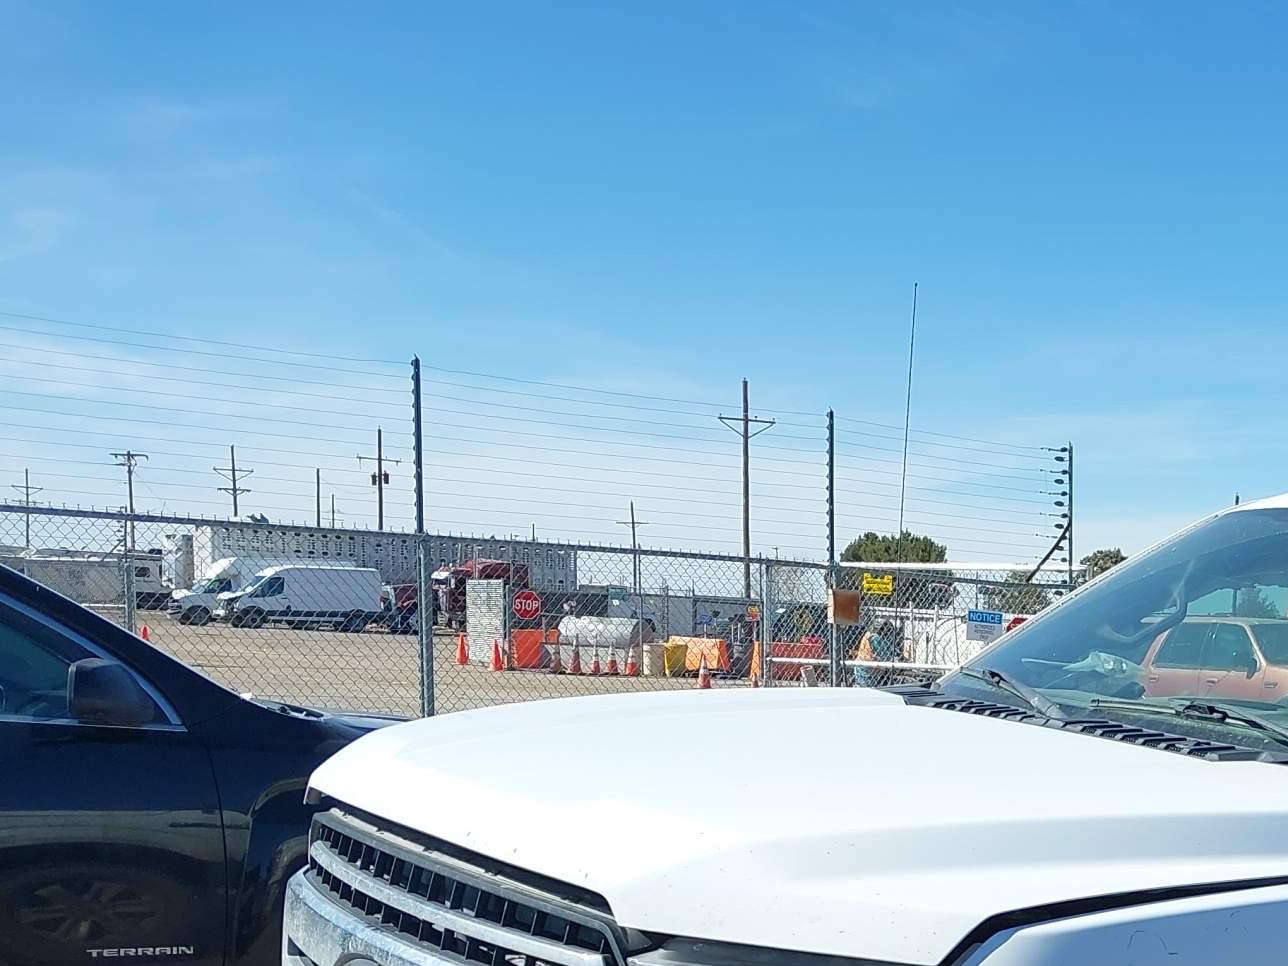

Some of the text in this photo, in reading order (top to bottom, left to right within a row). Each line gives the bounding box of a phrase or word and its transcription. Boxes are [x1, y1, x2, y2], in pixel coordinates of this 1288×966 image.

[515, 598, 538, 610] STOP
[969, 612, 1001, 623] NOTICE
[86, 945, 194, 958] TERRAIN
